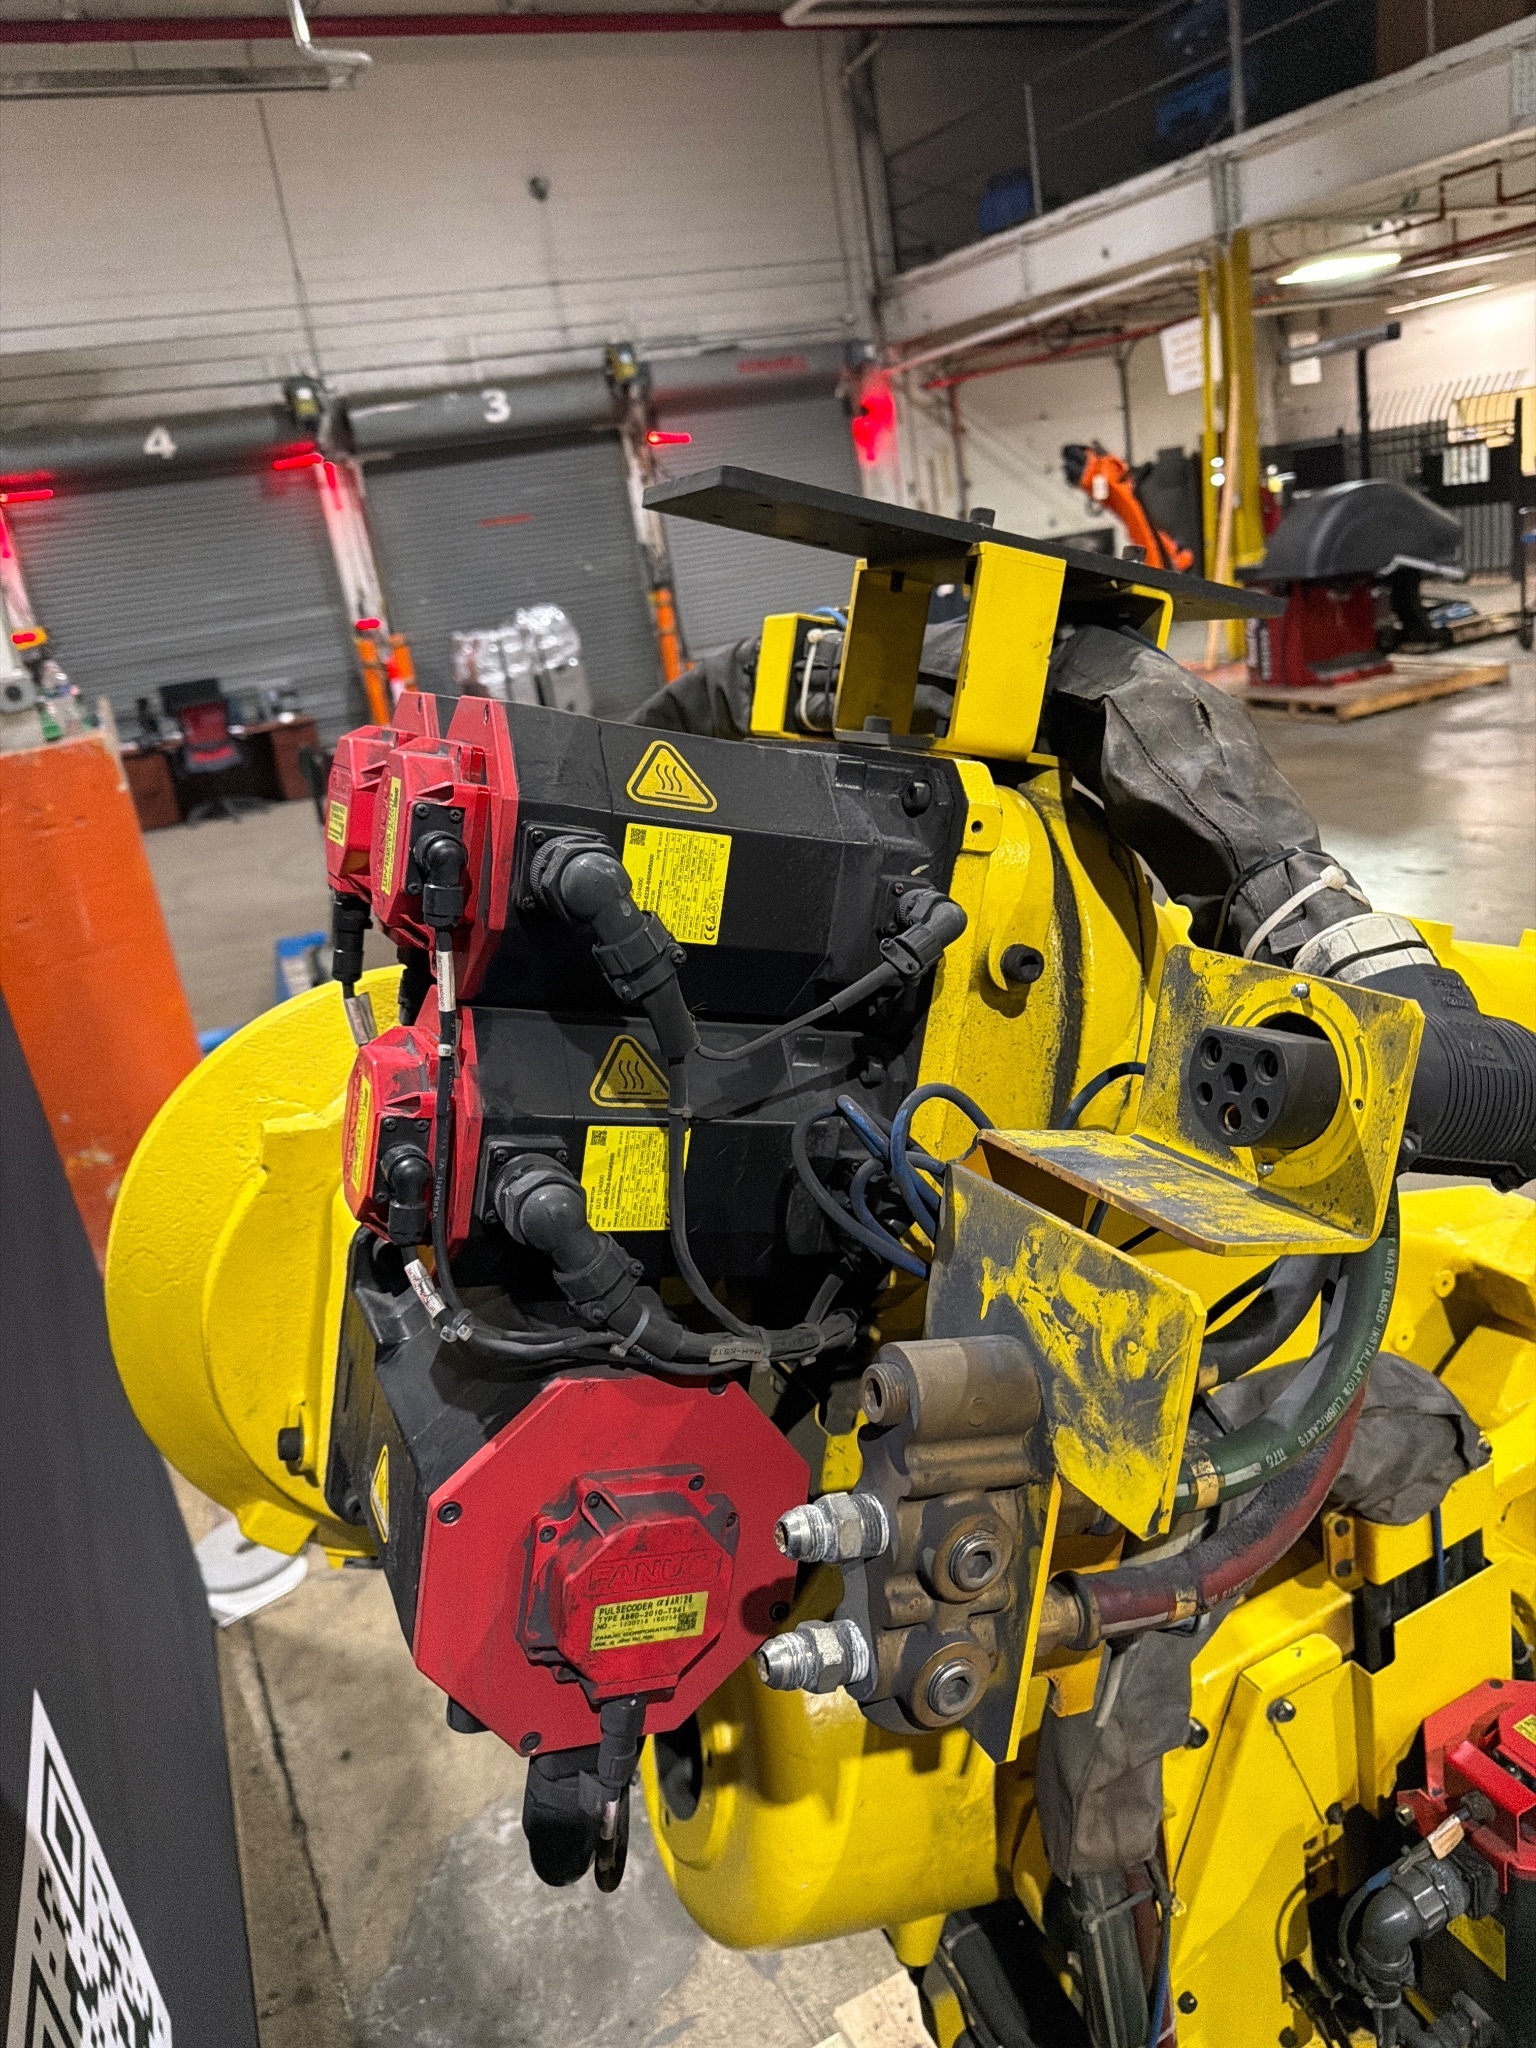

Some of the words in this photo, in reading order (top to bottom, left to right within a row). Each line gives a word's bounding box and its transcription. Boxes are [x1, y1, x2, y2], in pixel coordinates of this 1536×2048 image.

[481, 389, 511, 423] 3
[143, 426, 177, 459] 4
[433, 1175, 444, 1218] VERSAFIT
[1383, 1248, 1396, 1285] WATER
[1376, 1288, 1391, 1324] BASED
[1342, 1326, 1381, 1396] INSTALLATION
[1297, 1396, 1345, 1448] LUBRICANTS
[588, 1555, 710, 1590] FANUC
[598, 1614, 617, 1624] TYPE
[599, 1601, 653, 1616] PULSECODER
[622, 1624, 676, 1636] CORPORATION
